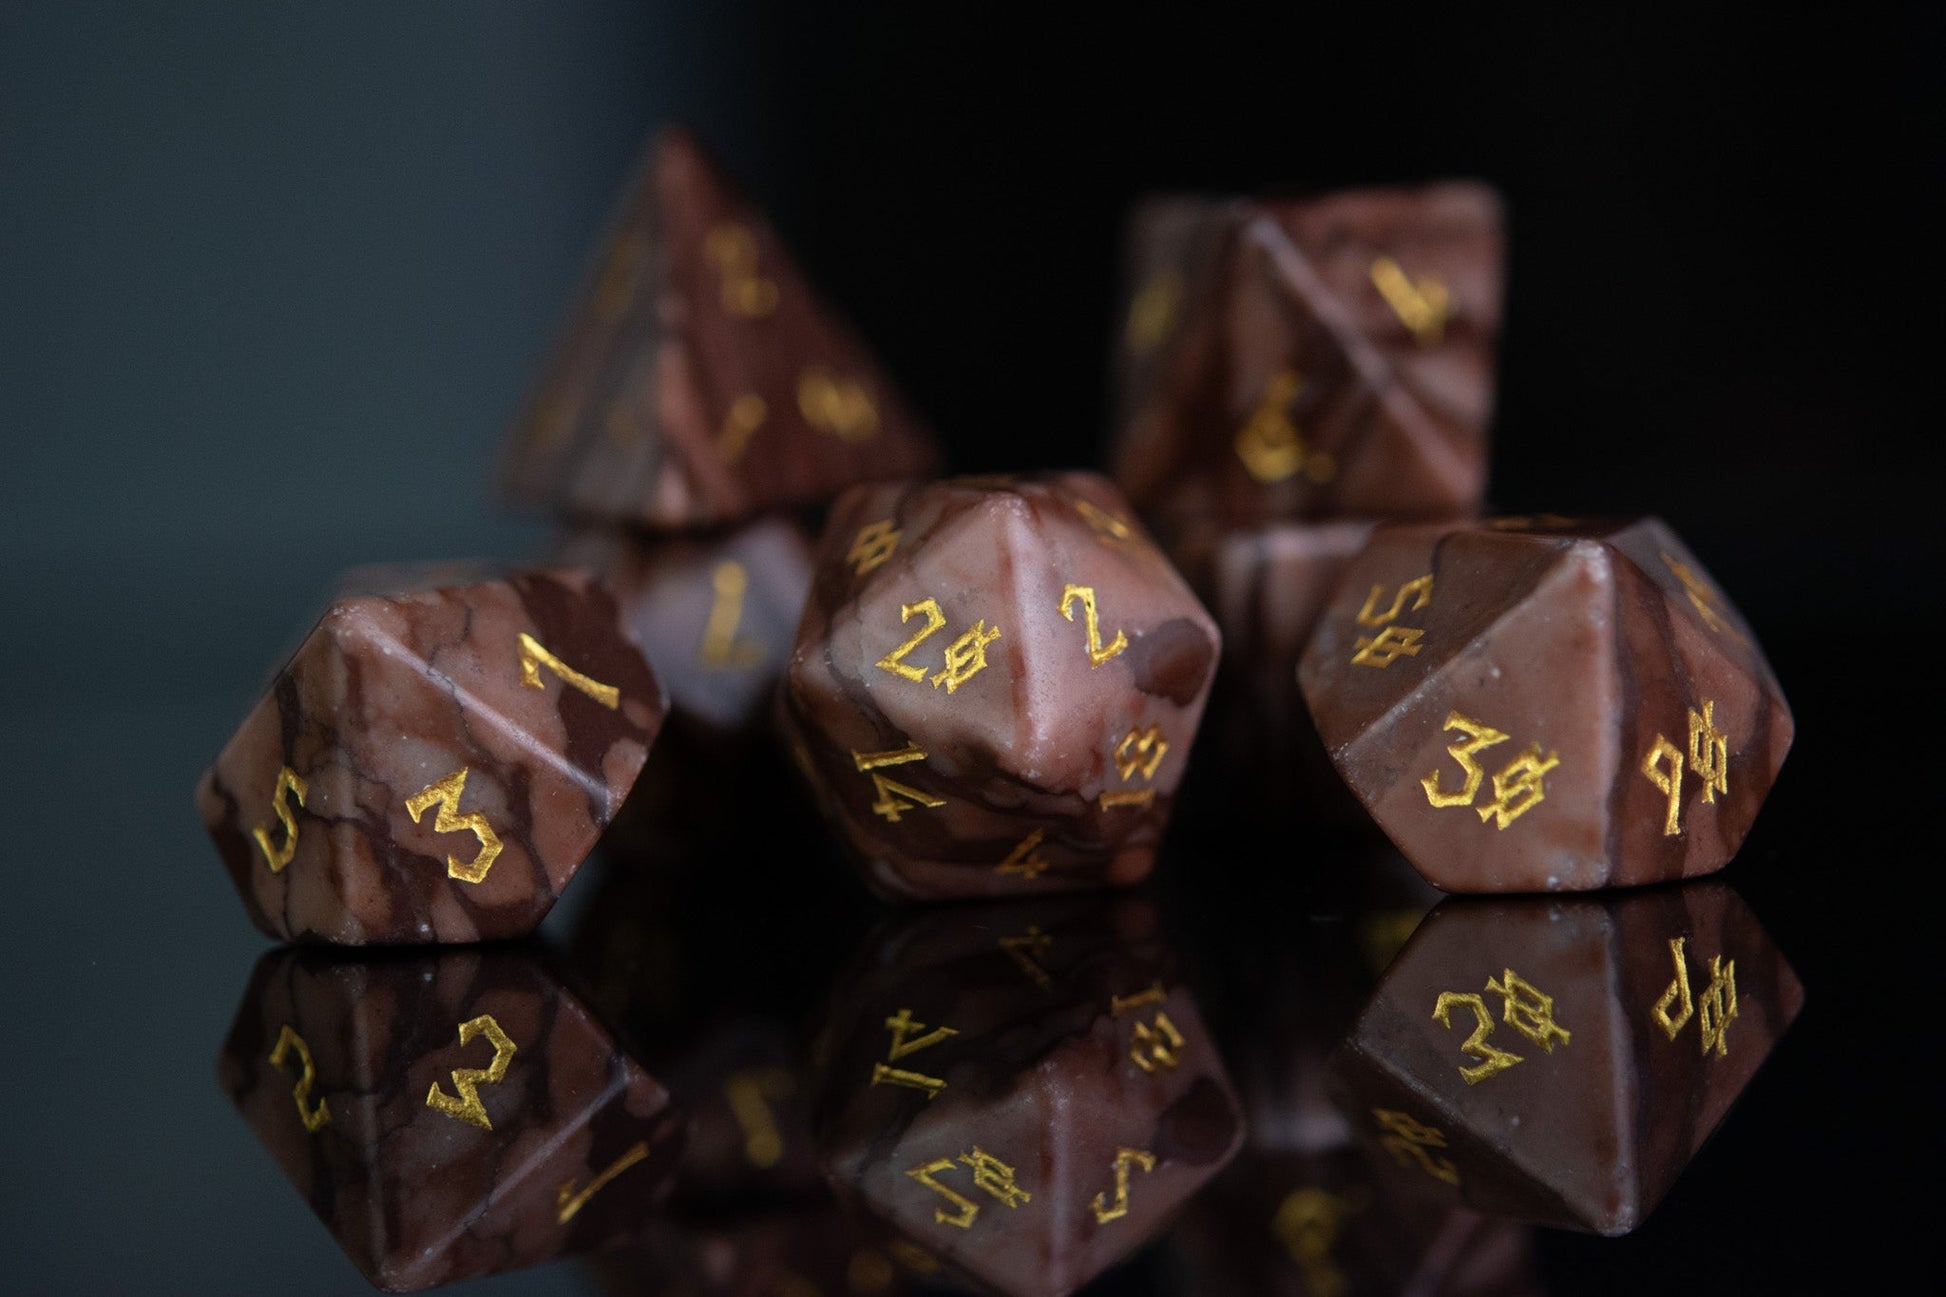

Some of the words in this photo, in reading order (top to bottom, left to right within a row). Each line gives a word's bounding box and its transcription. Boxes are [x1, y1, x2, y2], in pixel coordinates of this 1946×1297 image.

[1057, 583, 1129, 669] 2
[253, 766, 308, 873] 5
[405, 766, 504, 884] 3
